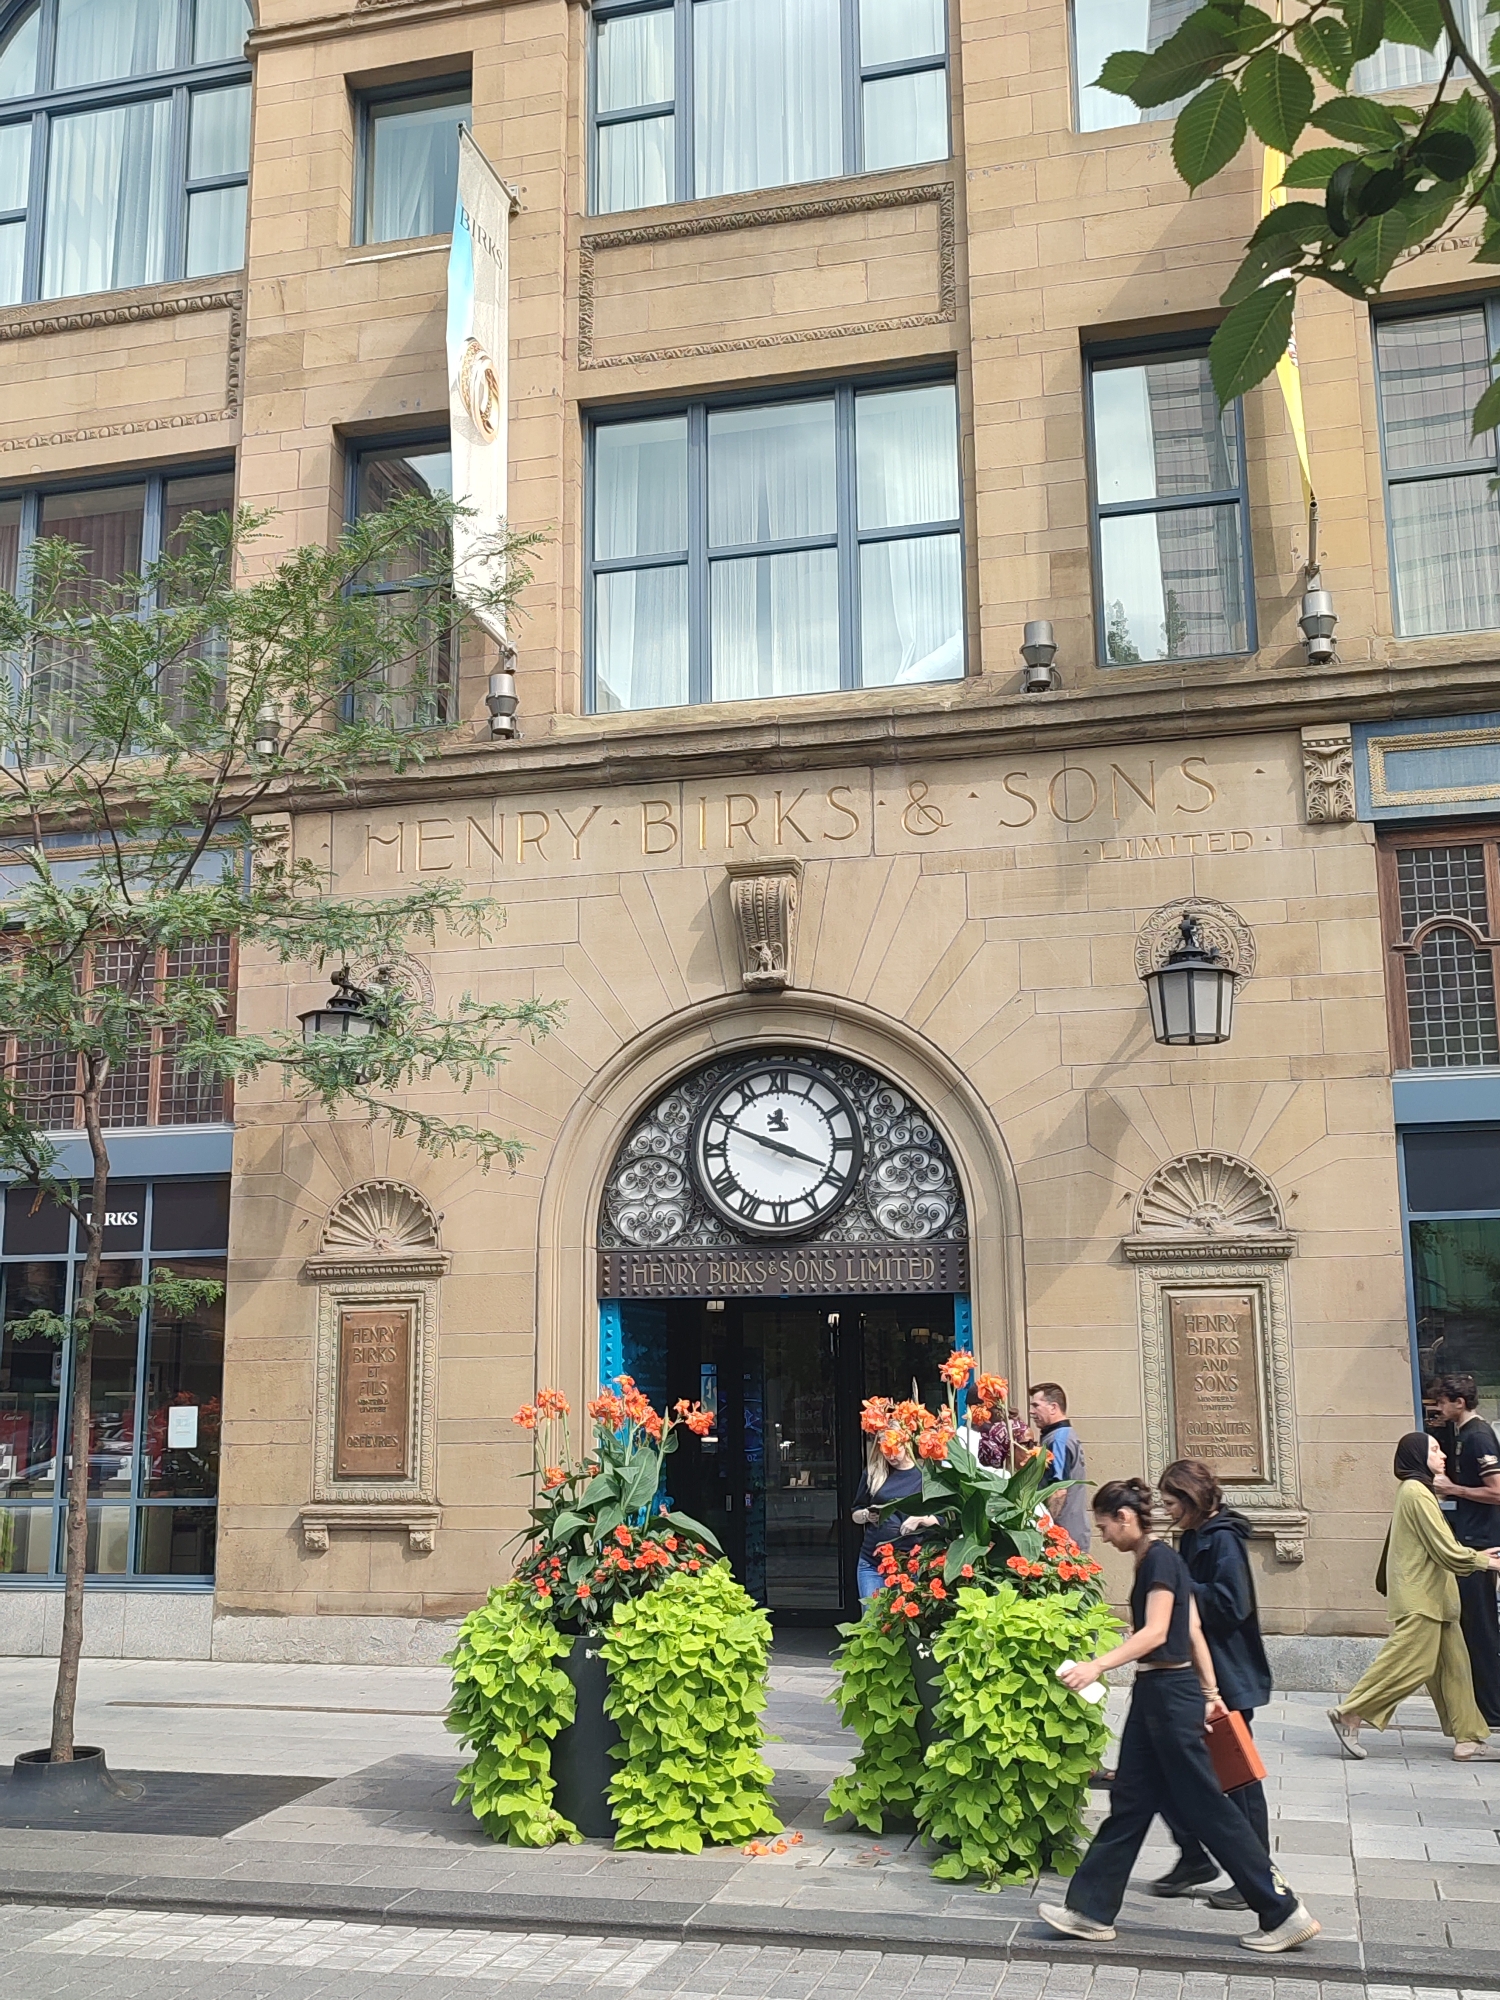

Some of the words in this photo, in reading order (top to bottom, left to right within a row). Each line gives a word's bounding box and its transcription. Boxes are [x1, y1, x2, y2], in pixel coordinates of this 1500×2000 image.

[459, 204, 503, 270] BIRKS
[364, 806, 602, 876] HENRY
[640, 785, 860, 855] BIRKS
[901, 780, 953, 835] &
[998, 757, 1217, 827] SONS
[1099, 830, 1254, 861] LIMITED
[86, 1211, 138, 1226] RKS
[631, 1262, 704, 1286] HENRY
[708, 1260, 767, 1284] BIRKS
[780, 1259, 837, 1283] SONS
[846, 1257, 935, 1282] LIMITED
[1184, 1314, 1240, 1333] HENRY
[351, 1326, 400, 1344] HENRY
[353, 1347, 397, 1363] BIRKS
[1187, 1337, 1240, 1356] BIRKS
[367, 1366, 380, 1378] ET
[1201, 1358, 1229, 1372] AND
[359, 1381, 387, 1396] FILS
[1194, 1375, 1239, 1393] SONS
[1186, 1421, 1251, 1436] GOLDSMITHS
[1184, 1444, 1256, 1458] SILVERSMITHS
